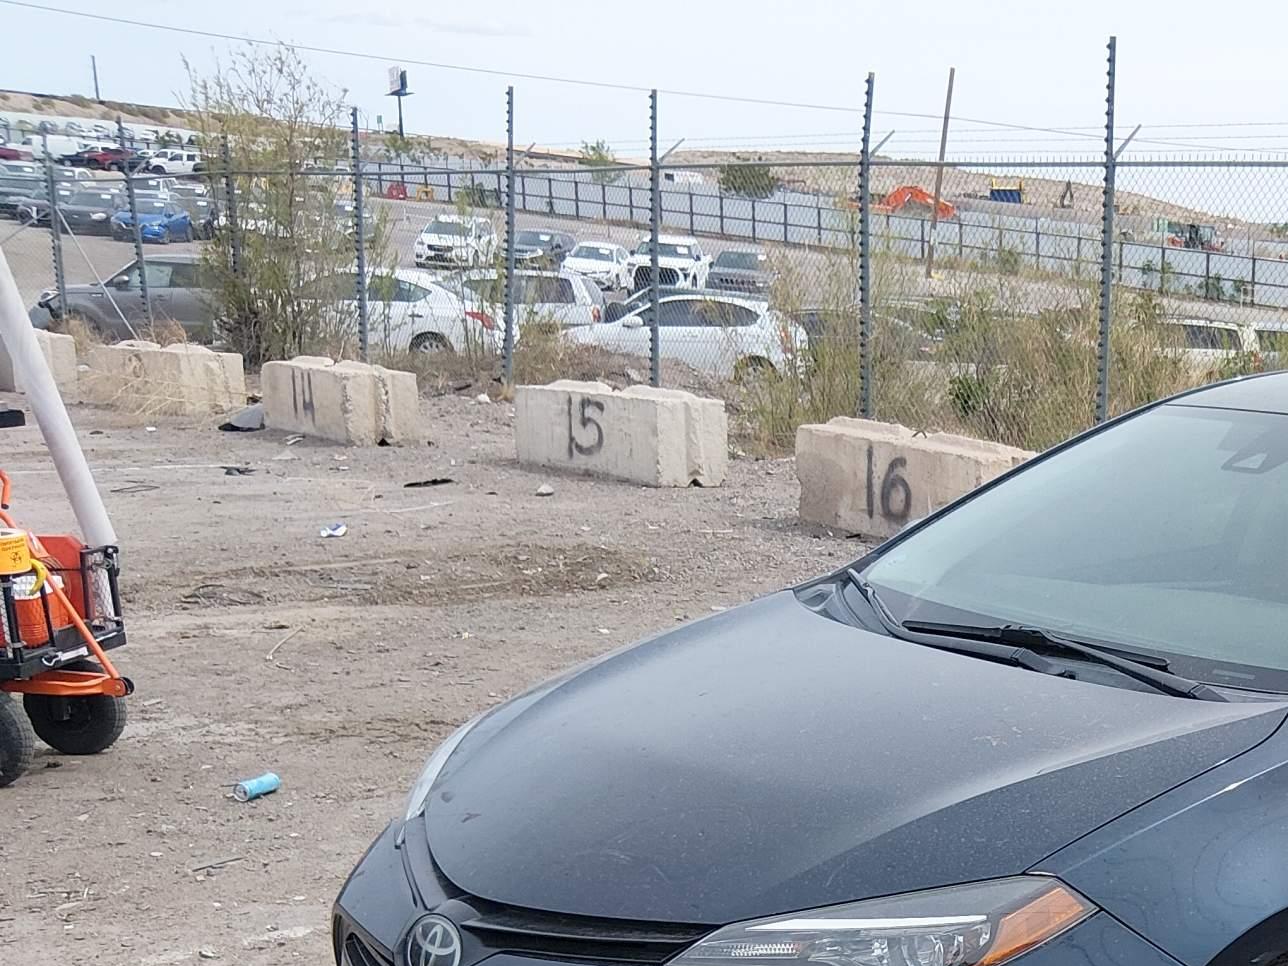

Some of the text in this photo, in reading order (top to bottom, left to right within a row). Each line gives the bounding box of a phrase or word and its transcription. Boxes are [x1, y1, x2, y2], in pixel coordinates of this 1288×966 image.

[290, 367, 316, 427] 14
[567, 391, 605, 459] 15
[866, 442, 912, 521] 16
